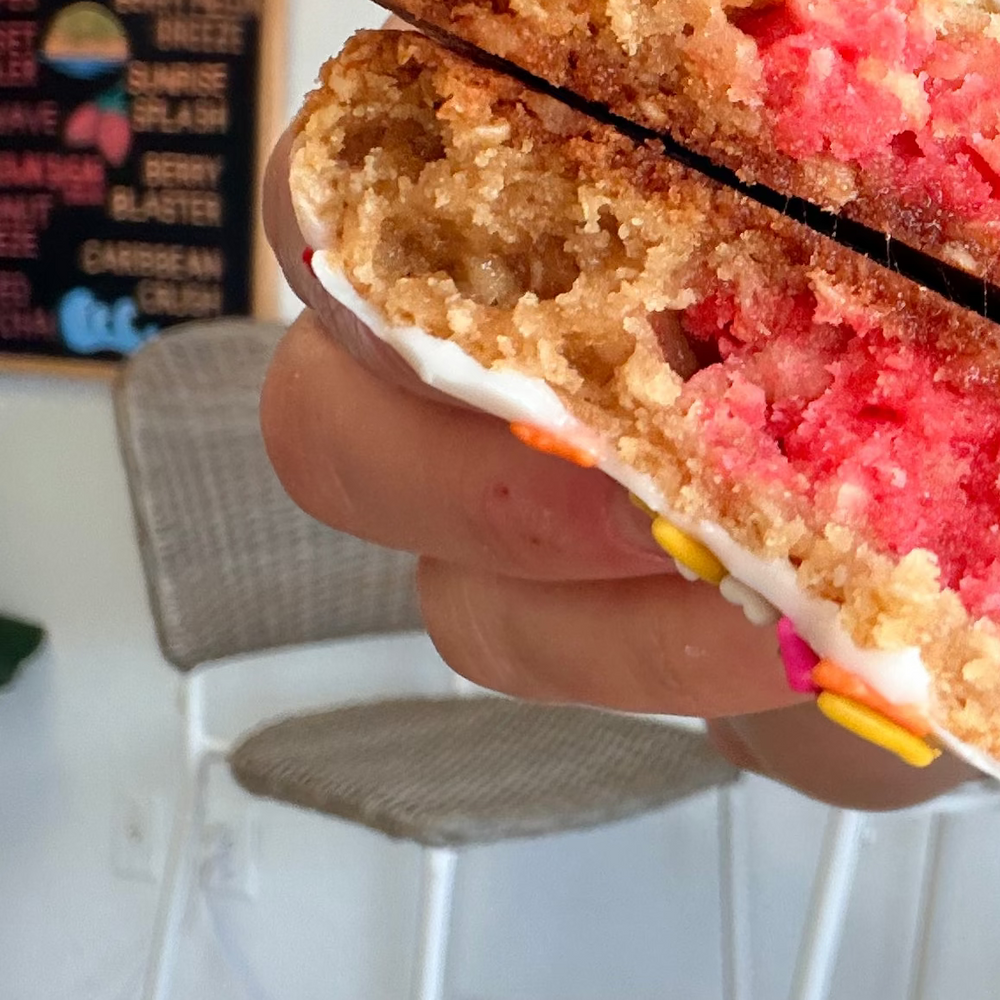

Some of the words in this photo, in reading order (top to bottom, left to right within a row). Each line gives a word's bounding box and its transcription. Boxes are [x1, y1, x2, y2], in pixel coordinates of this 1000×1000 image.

[128, 60, 228, 98] SUNRISE
[131, 98, 228, 134] SPLASH
[143, 150, 223, 188] BERRY
[109, 185, 222, 226] BLASTER
[80, 238, 224, 281] CARIBBEAN
